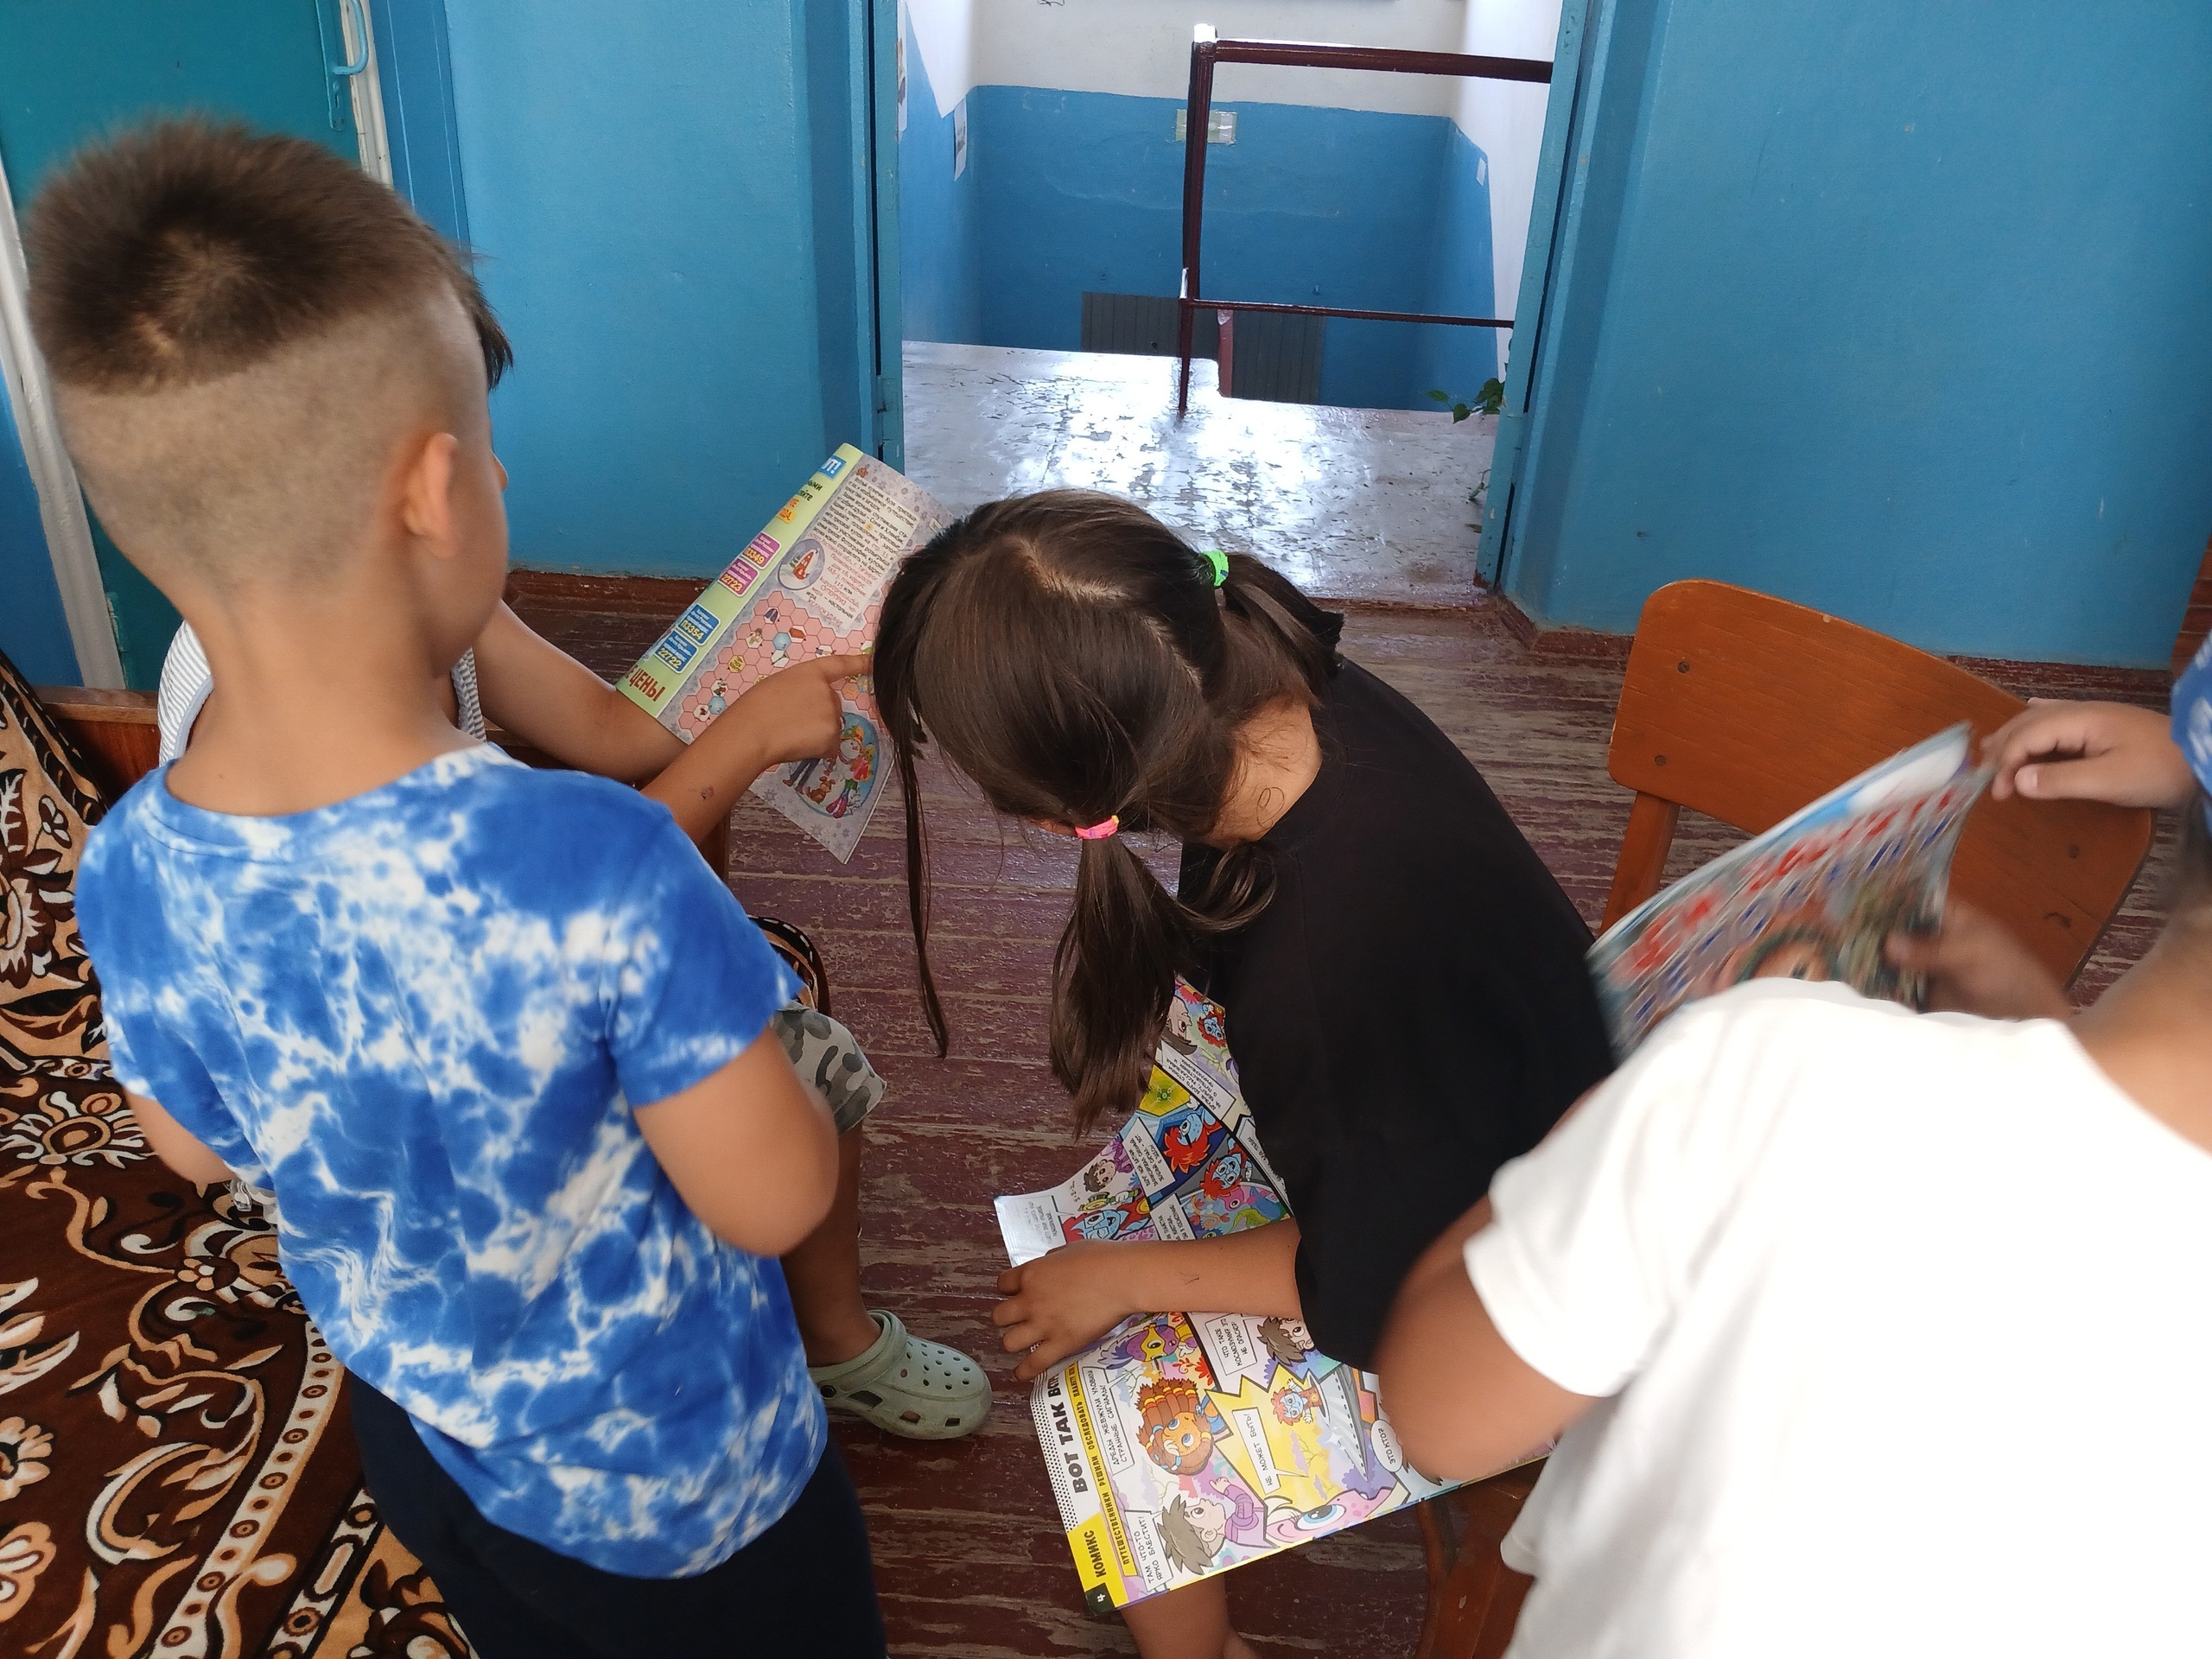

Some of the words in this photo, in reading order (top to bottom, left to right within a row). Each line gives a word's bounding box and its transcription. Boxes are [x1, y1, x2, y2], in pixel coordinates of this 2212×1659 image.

[869, 517, 881, 527] Соня
[657, 646, 682, 669] 22722
[626, 667, 665, 702] ЦЕНЫ
[1214, 1327, 1225, 1344] ТАКОЕ
[1220, 1345, 1230, 1357] ЧТО
[1093, 1397, 1110, 1435] ЖЕВЖУЛИ
[1097, 1383, 1114, 1419] СИГНАЛЫ!
[1050, 1401, 1074, 1445] ТАК
[1074, 1401, 1095, 1450] ОБСЛЕДОВАТЬ
[1243, 1412, 1256, 1437] БЫТЬ!
[1377, 1427, 1390, 1448] КТО?
[1104, 1439, 1119, 1465] ДРЕДЫ
[1109, 1422, 1127, 1463] СТРАННЫЕ
[1253, 1441, 1268, 1471] МОЖЕТ
[1385, 1448, 1395, 1464] ЭТО
[1063, 1450, 1088, 1493] ВОТ
[1090, 1454, 1106, 1486] РЕШИЛИ
[1264, 1475, 1273, 1485] НЕ
[1101, 1491, 1130, 1565] ПУТЕШЕСТВЕННИКИ
[1137, 1515, 1155, 1554] БЛЕСТИТ!
[1083, 1529, 1107, 1577] КОМИКС
[1133, 1530, 1147, 1560] ЧТО-ТО
[1144, 1565, 1154, 1583] ТАМ
[1151, 1559, 1163, 1580] ЯРКО
[1096, 1592, 1106, 1603] 4
